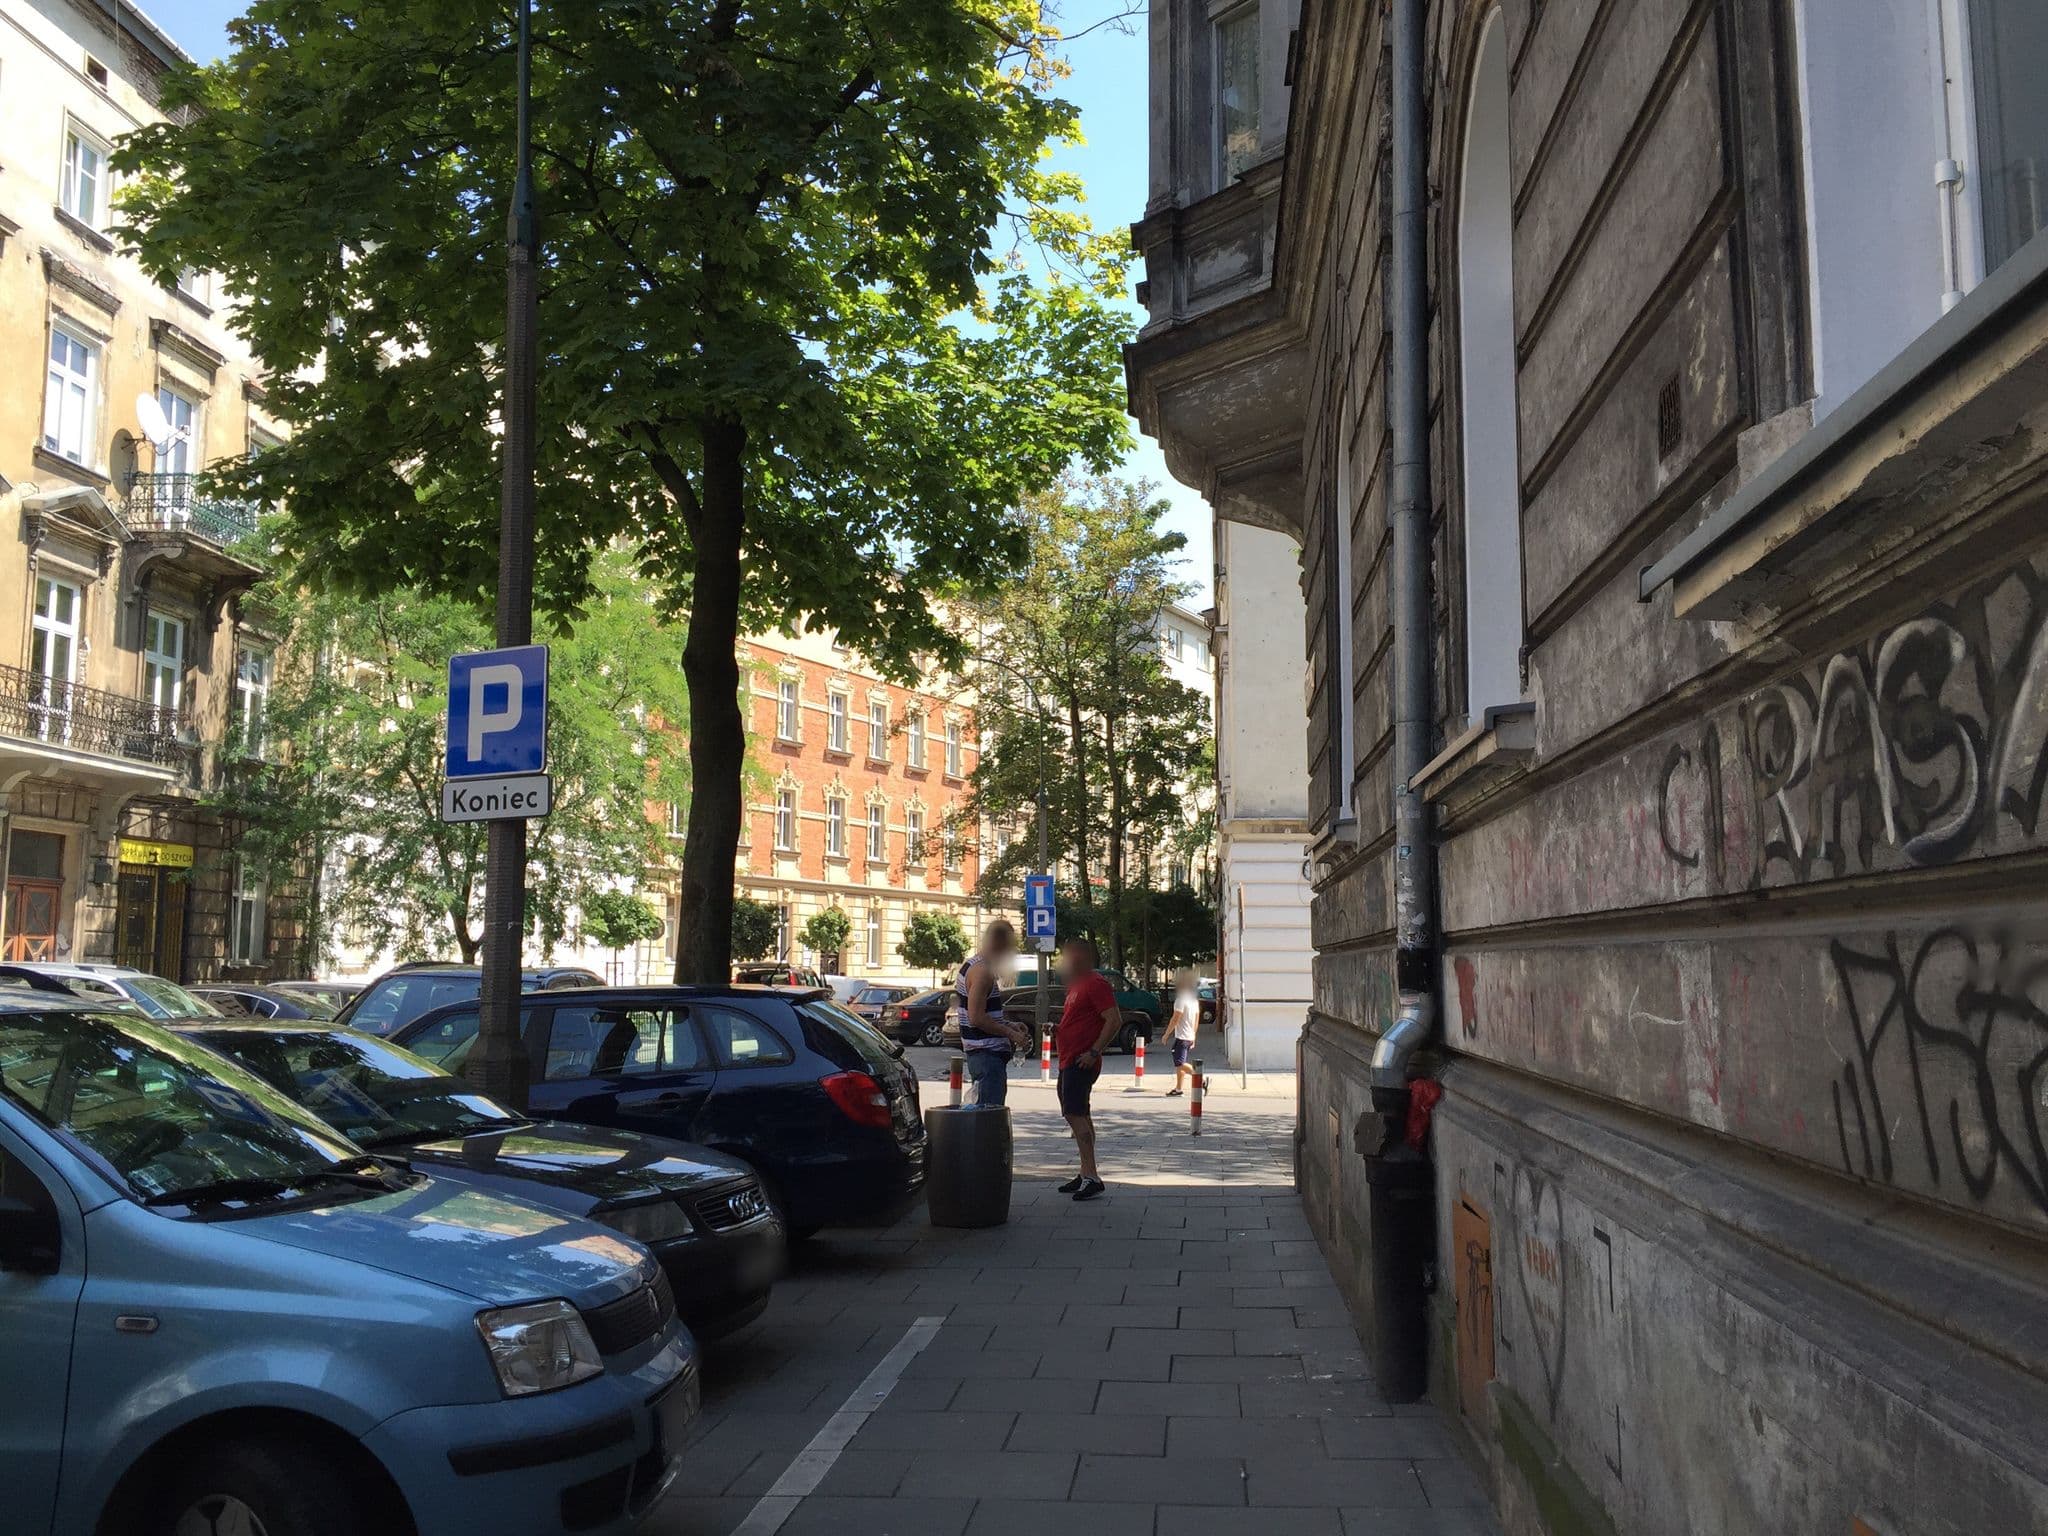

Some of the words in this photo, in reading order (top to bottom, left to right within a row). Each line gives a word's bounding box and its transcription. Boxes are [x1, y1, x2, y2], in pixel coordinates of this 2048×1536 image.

[467, 664, 523, 762] P
[452, 786, 538, 814] Koniec
[1033, 909, 1049, 934] P
